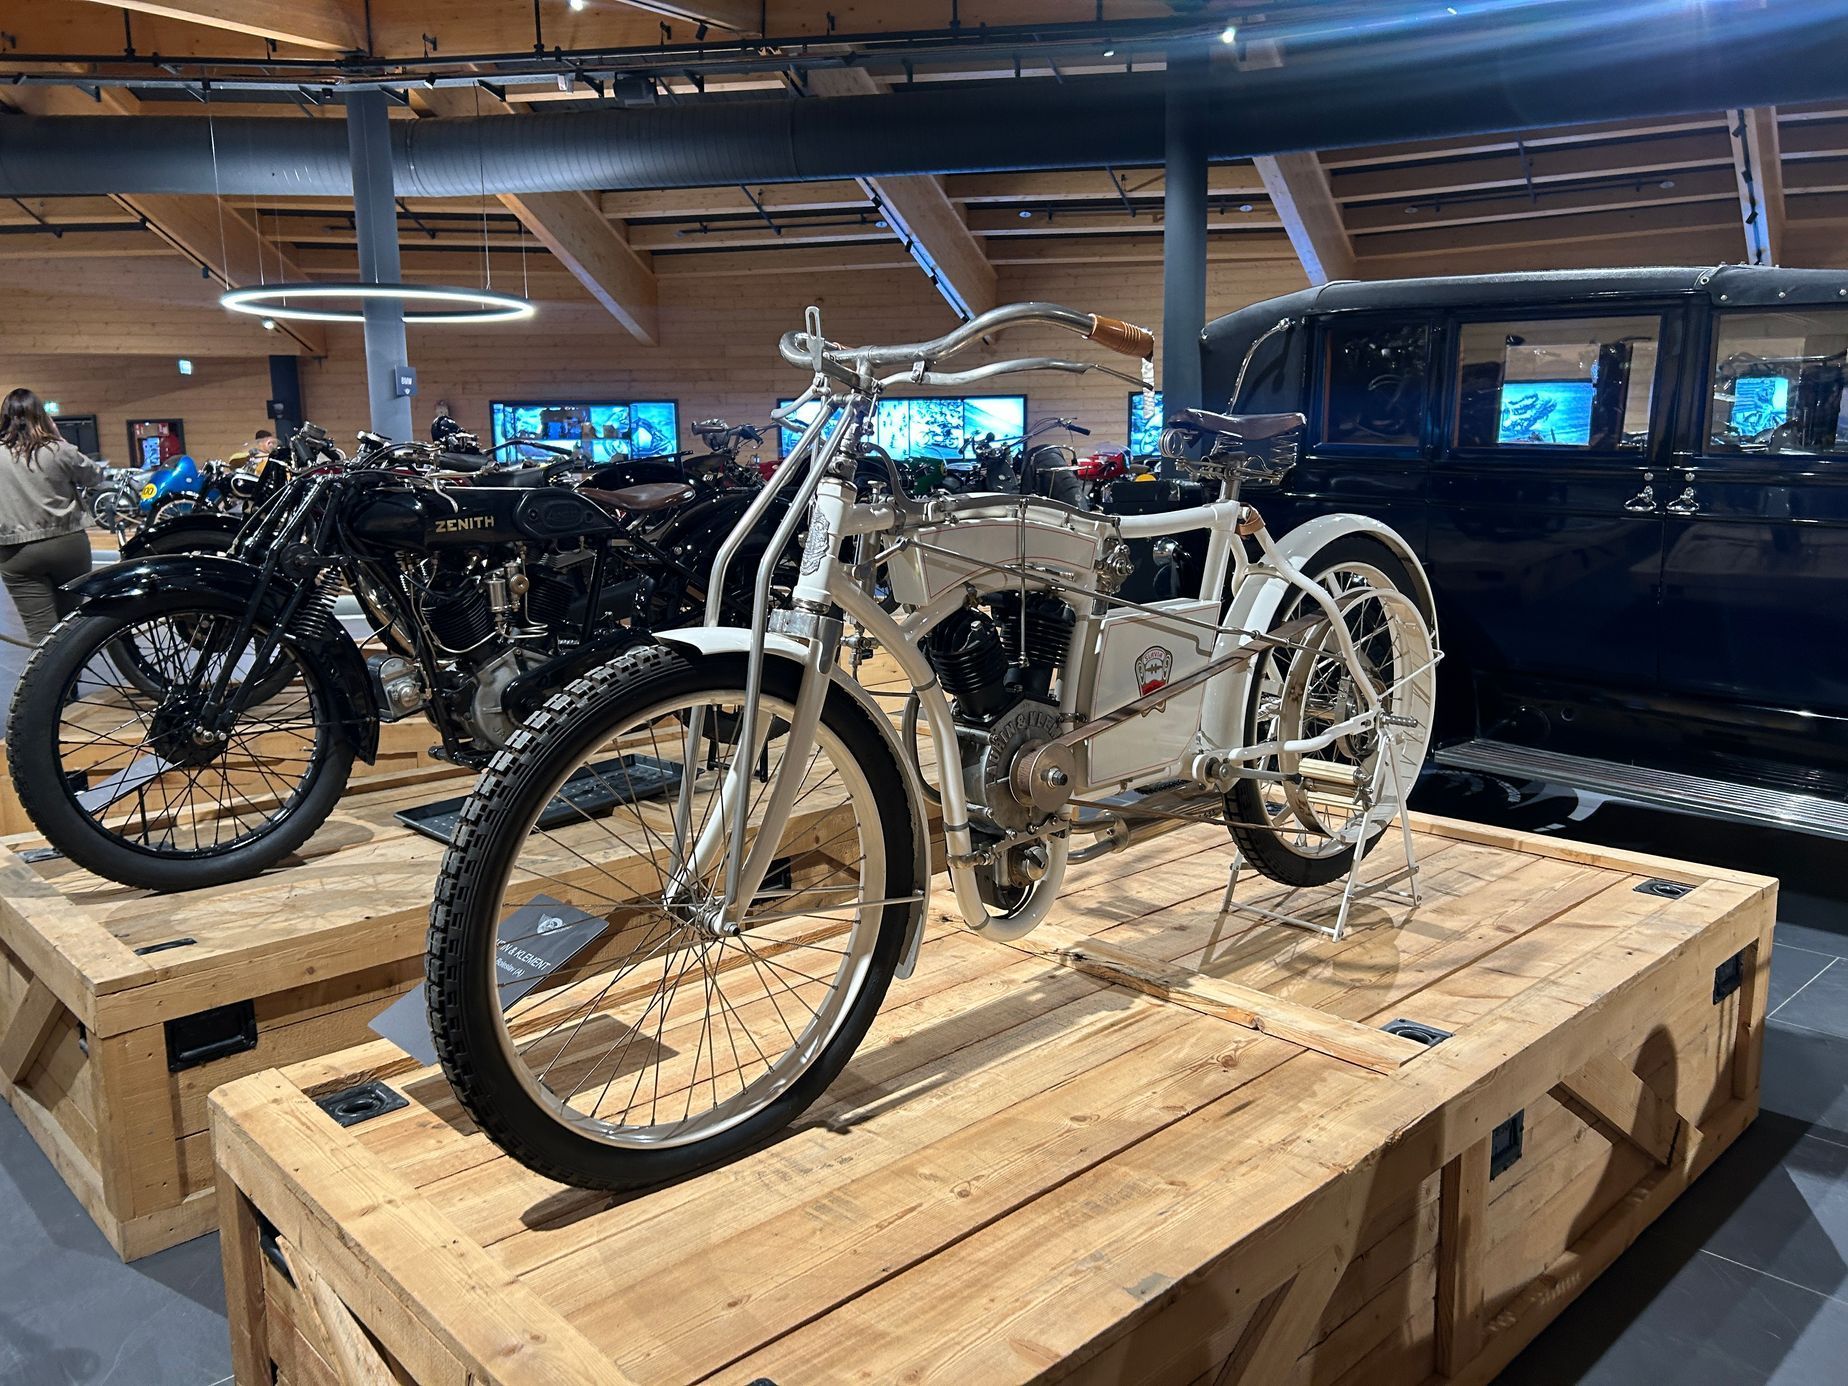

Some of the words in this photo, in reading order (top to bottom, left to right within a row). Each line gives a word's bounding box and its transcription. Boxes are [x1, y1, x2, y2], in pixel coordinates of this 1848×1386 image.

[435, 515, 495, 533] ZENITH
[508, 946, 518, 955] &
[513, 949, 552, 971] KLEMENT
